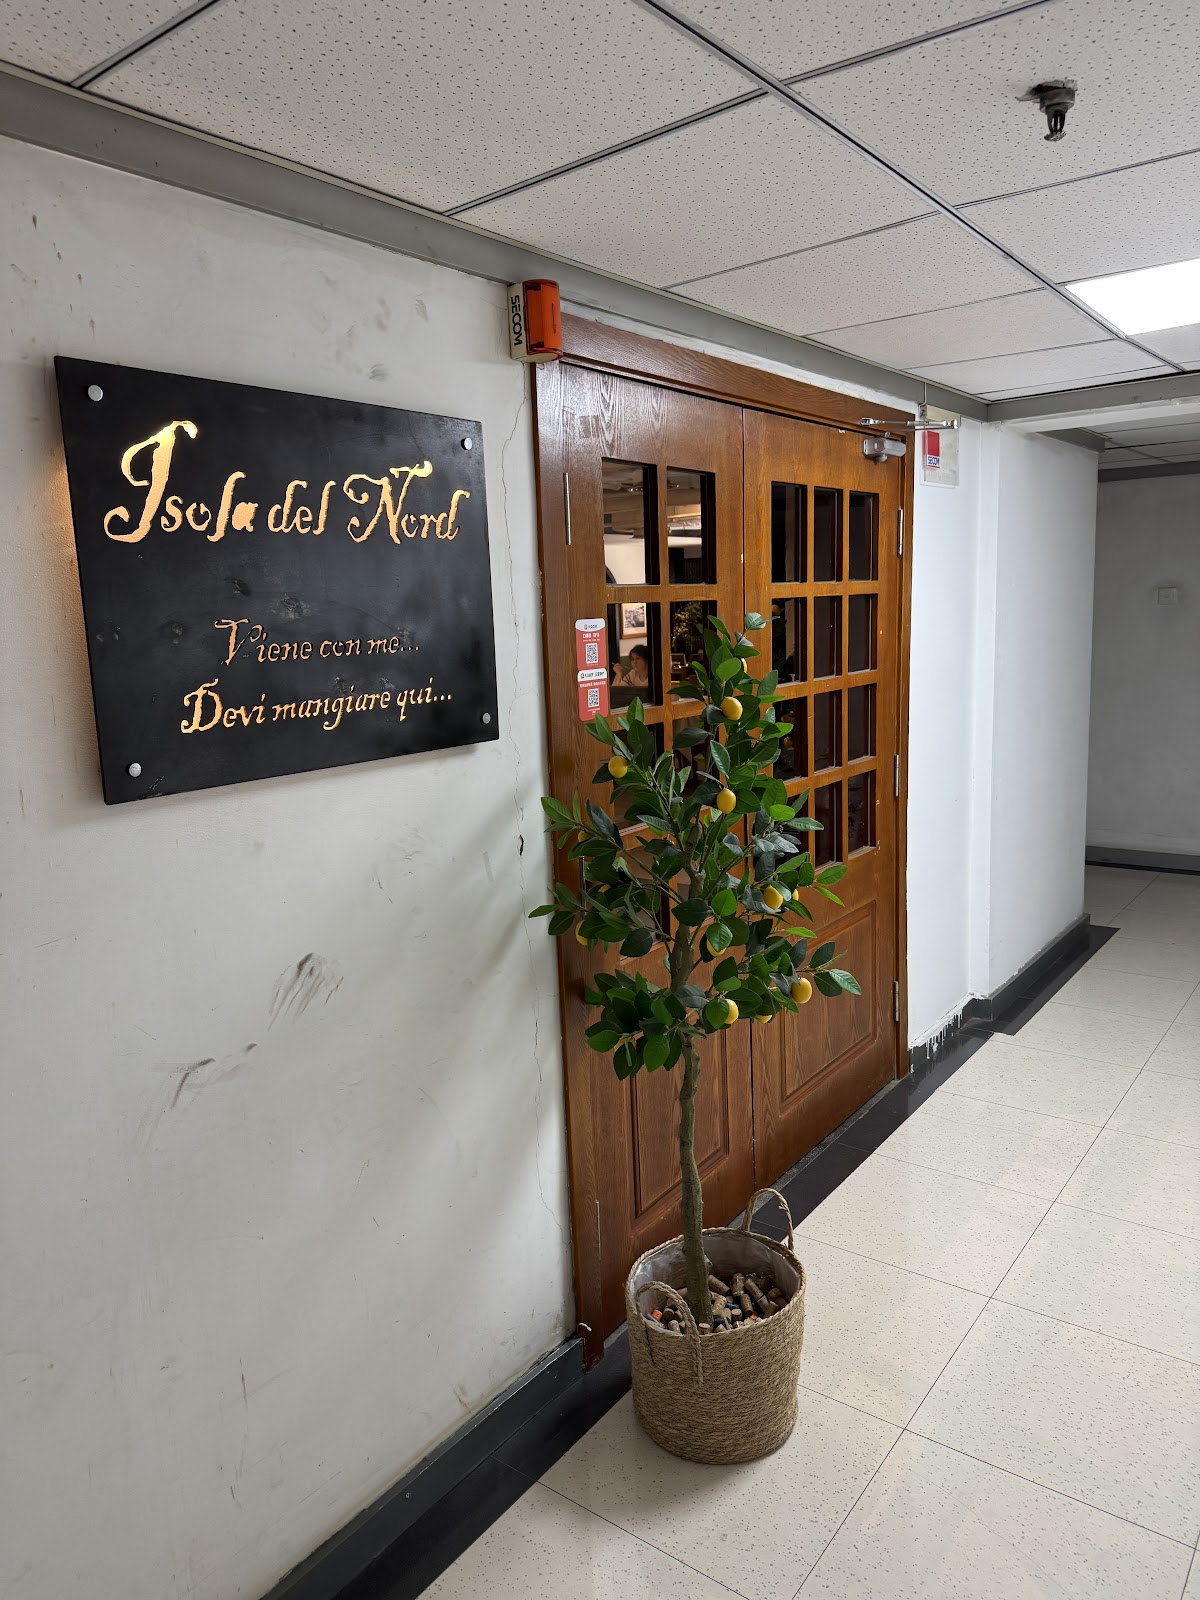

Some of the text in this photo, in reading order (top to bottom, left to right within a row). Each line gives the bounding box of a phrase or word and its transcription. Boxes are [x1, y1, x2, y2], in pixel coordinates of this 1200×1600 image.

[511, 294, 523, 346] SECOM
[104, 420, 471, 544] Isola del Nord
[214, 618, 312, 666] Viene
[319, 636, 361, 659] con
[180, 677, 452, 734] Devi mangiare qui...
